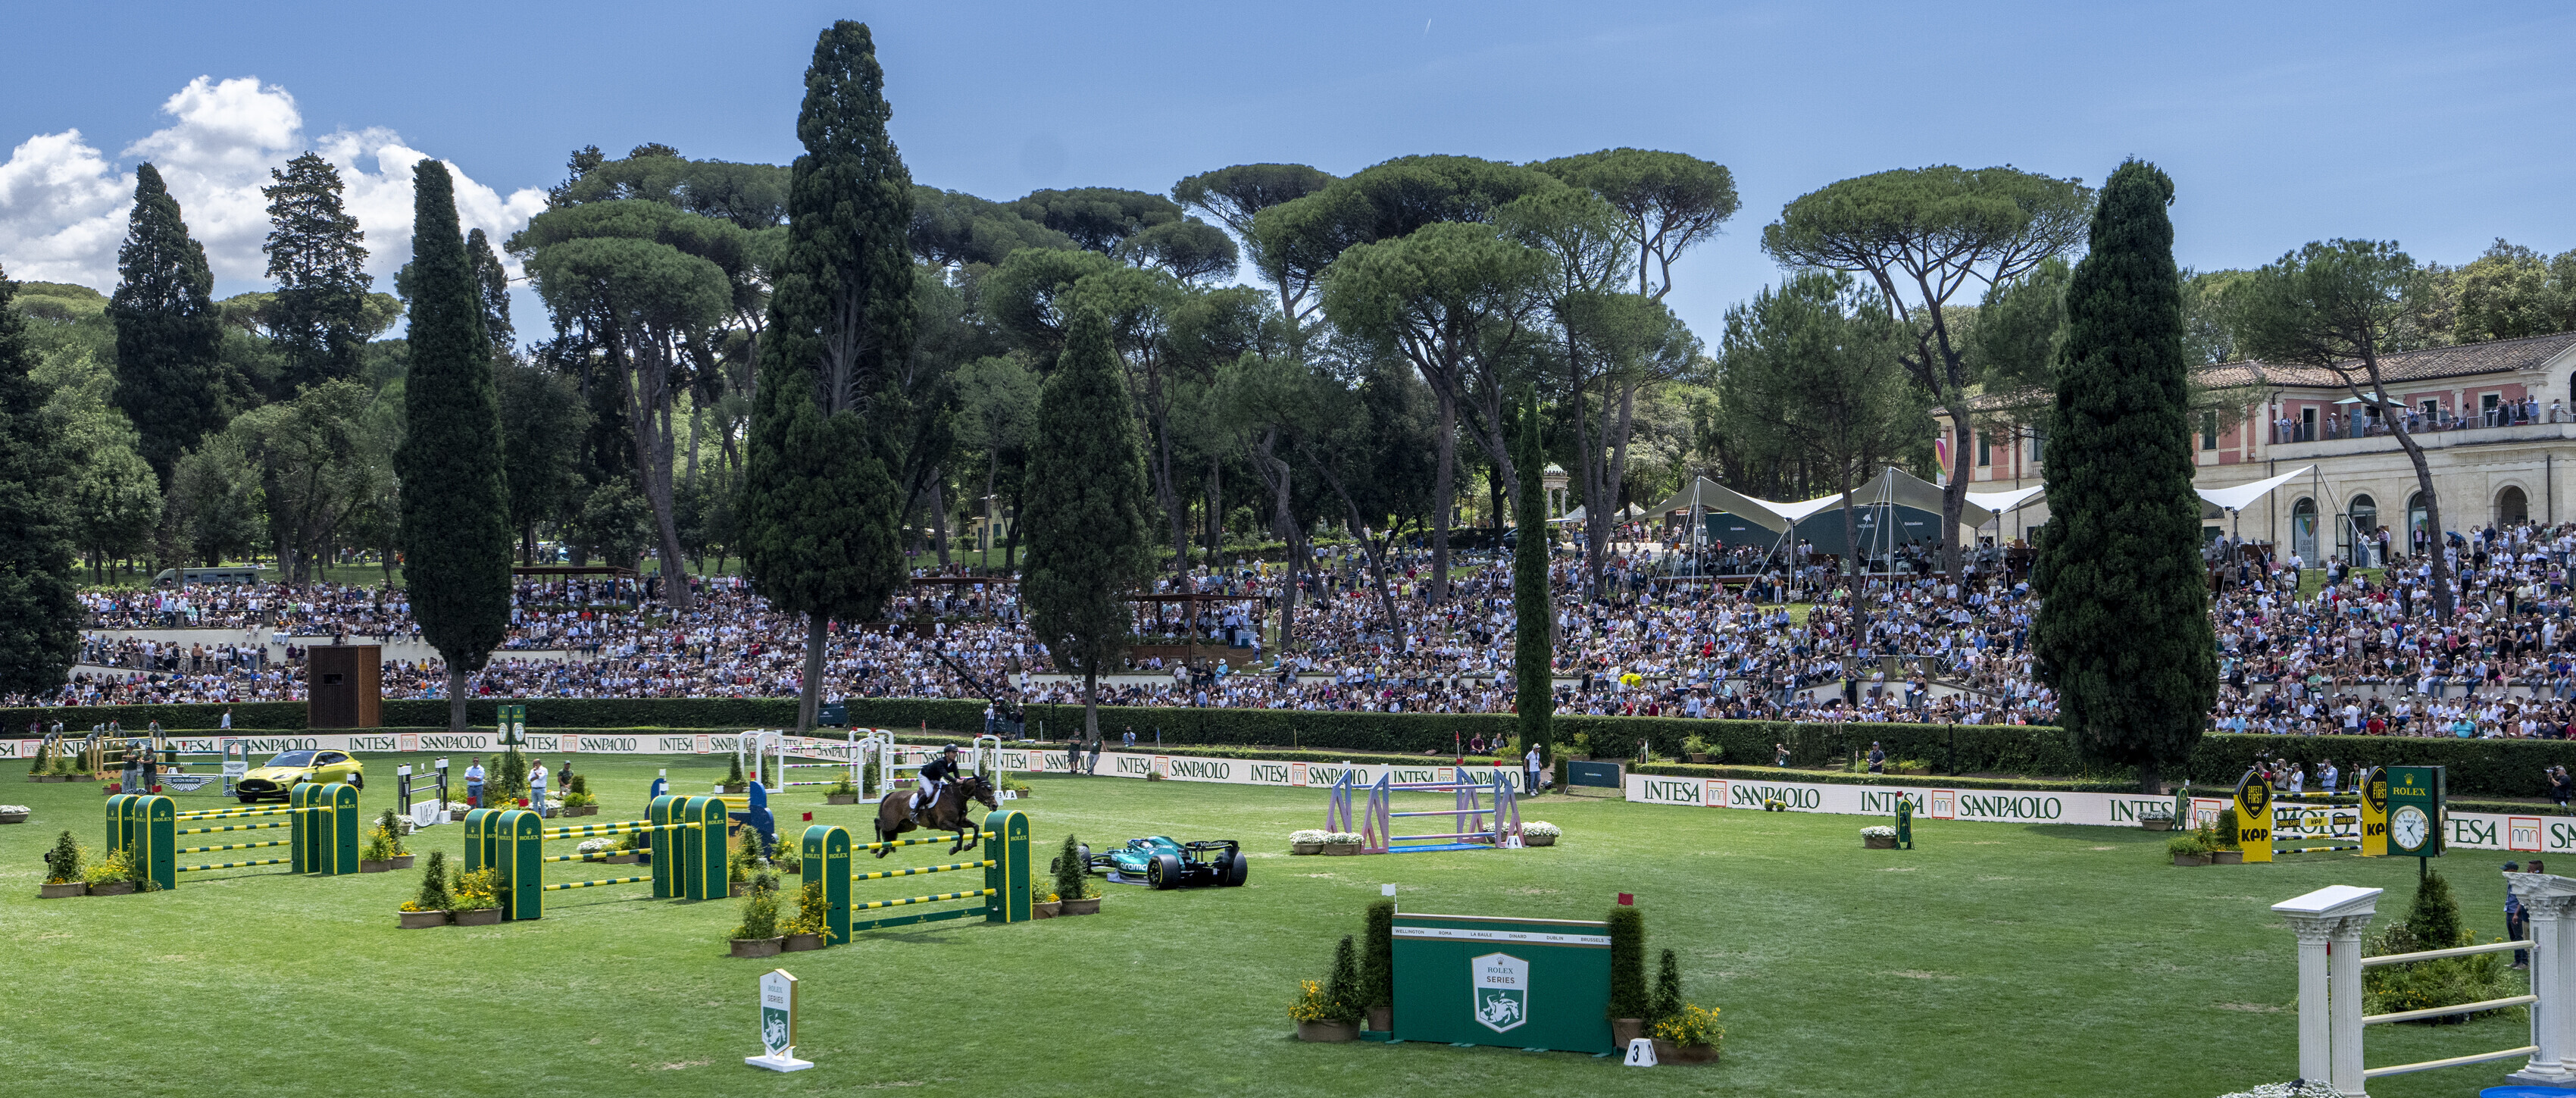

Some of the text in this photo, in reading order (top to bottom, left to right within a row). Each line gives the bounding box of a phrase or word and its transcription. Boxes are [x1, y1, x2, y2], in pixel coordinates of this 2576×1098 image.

[349, 736, 486, 749] INTESA SANPAOLO
[516, 737, 637, 751] NTESA SANPAOLO
[659, 738, 693, 751] INTESA
[1117, 756, 1230, 779] INTESA SANPAOLO
[1251, 765, 1289, 783] INTESA
[1394, 770, 1433, 783] INTESA
[1644, 780, 1821, 809] INTESA SANPAOLO
[2247, 785, 2263, 793] SAFETY
[2393, 787, 2426, 796] ROLEX
[2247, 793, 2263, 803] FIRST
[1960, 795, 2062, 819] SANPAOLO
[2109, 799, 2173, 821] INTES
[1121, 862, 1148, 871] aramc
[767, 984, 783, 993] ROLEX
[767, 994, 783, 1003] SERIES
[1633, 1044, 1640, 1062] 3
